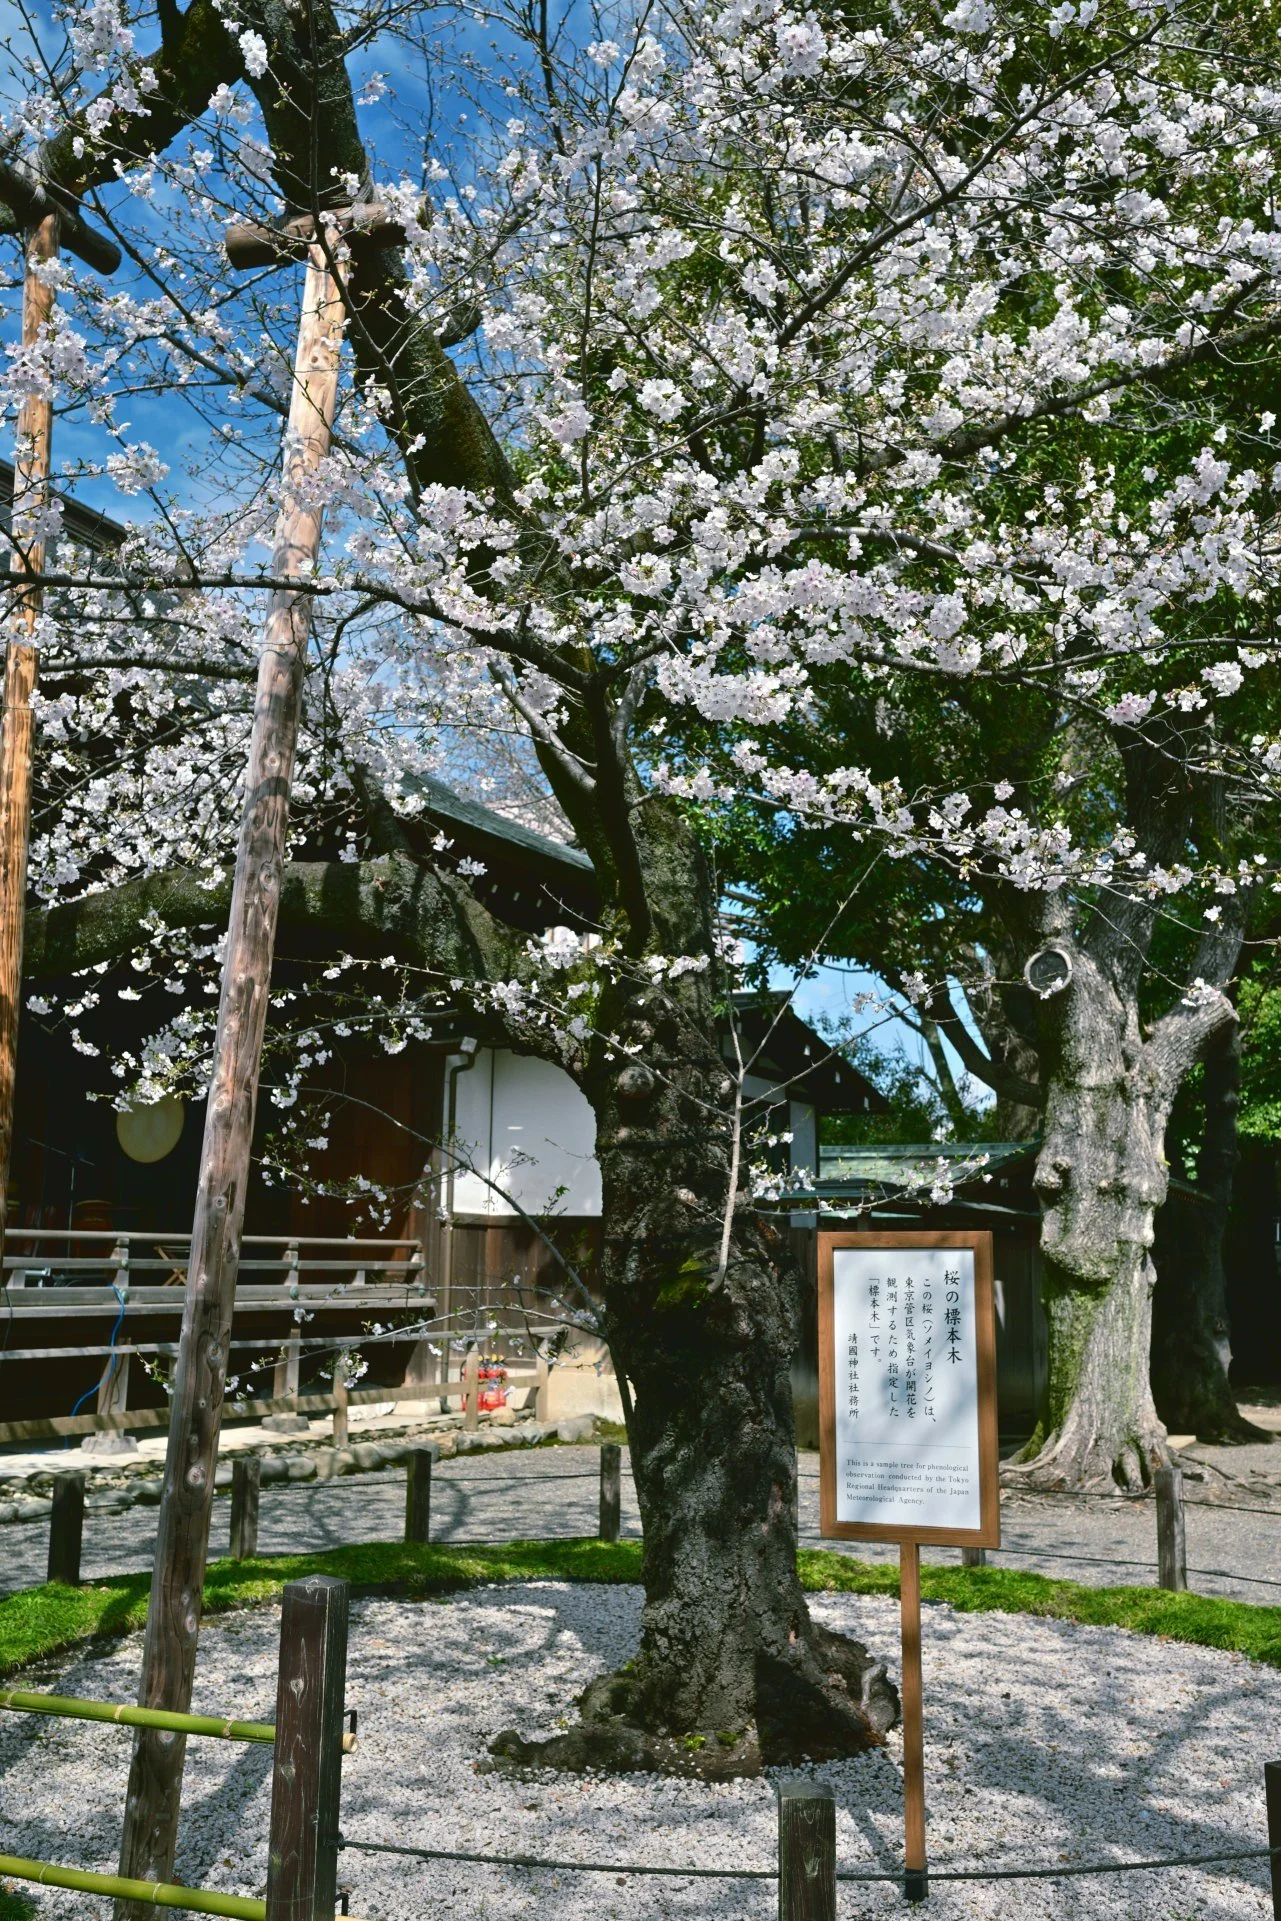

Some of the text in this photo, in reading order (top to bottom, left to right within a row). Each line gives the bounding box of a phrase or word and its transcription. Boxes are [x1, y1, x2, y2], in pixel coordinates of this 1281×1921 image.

[868, 1277, 882, 1363] 「標本木」です。
[944, 1269, 963, 1365] 桜の標本木
[886, 1276, 899, 1418] 観測するため指定した
[904, 1276, 917, 1419] 東京管区気象台が開花を
[845, 1470, 969, 1484] observation conducted by the Tokyo
[846, 1481, 969, 1496] Regional Headquarters of the Japan
[847, 1459, 861, 1467] This
[876, 1461, 899, 1469] sample
[916, 1462, 926, 1470] for
[927, 1463, 969, 1472] phenological
[846, 1493, 925, 1505] Meteorological Agency.
